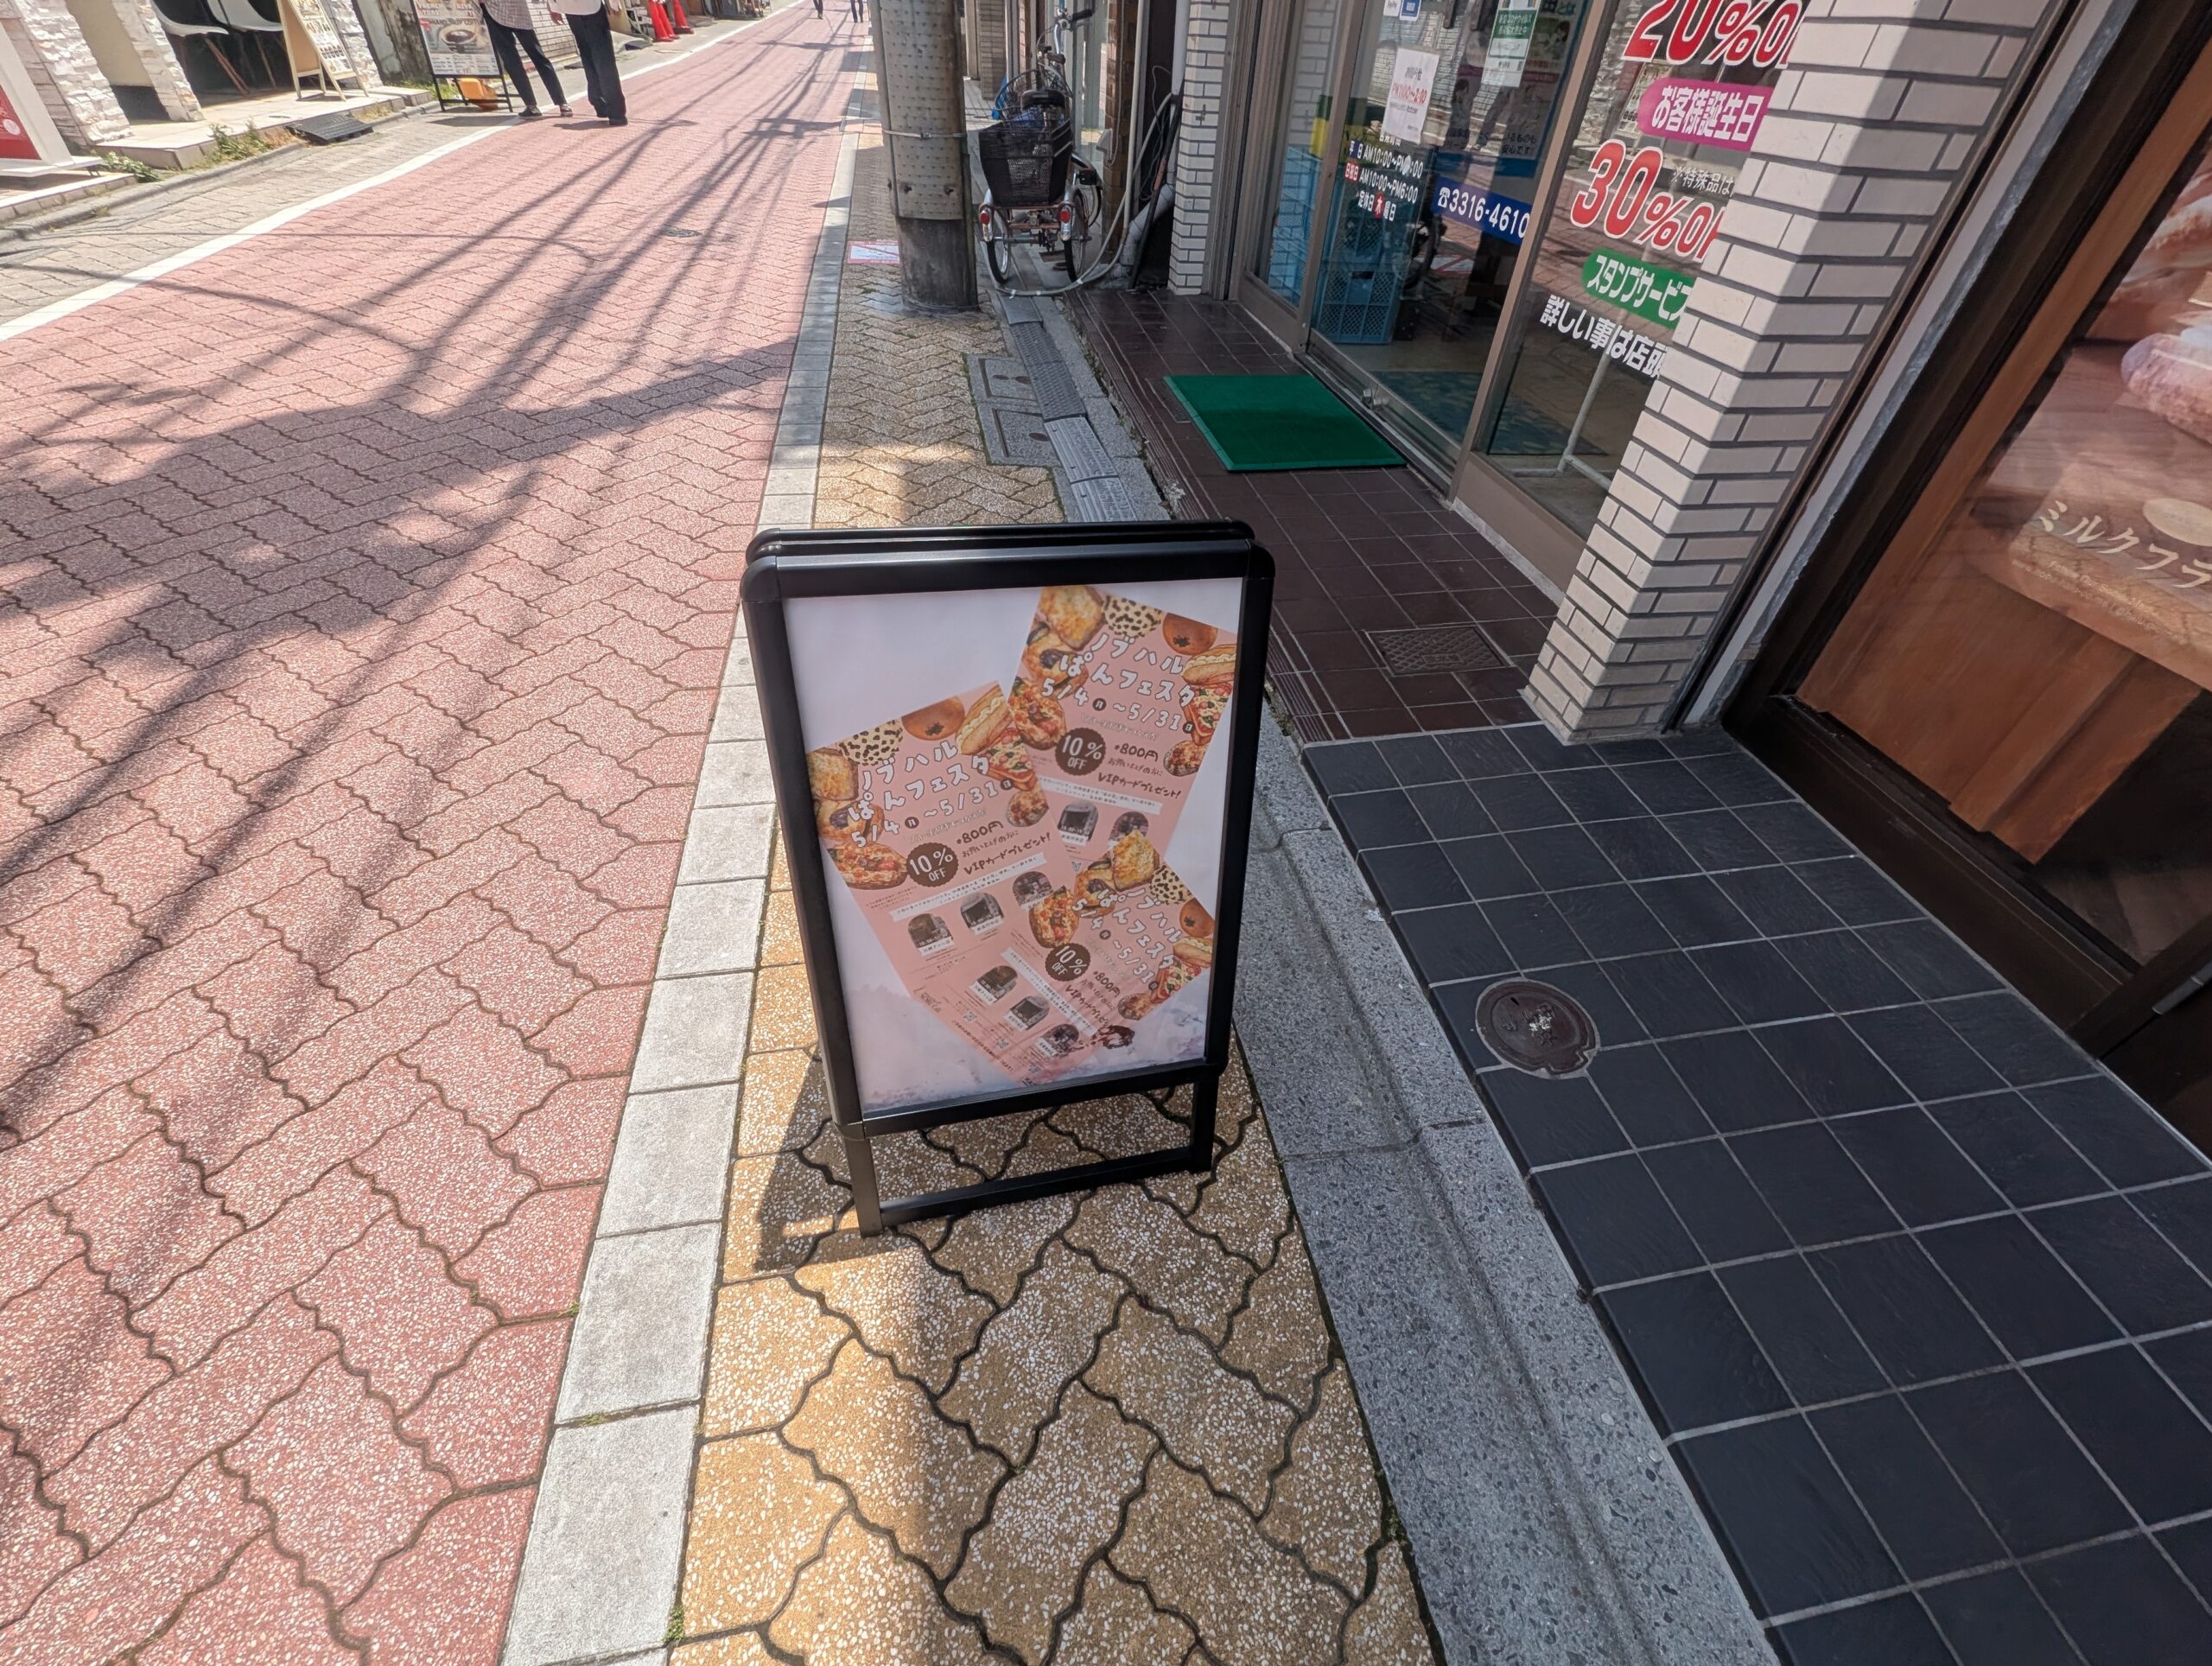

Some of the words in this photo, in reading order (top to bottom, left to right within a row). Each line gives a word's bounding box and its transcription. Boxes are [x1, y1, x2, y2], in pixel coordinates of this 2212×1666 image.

[1621, 0, 1802, 69] 20%O
[1651, 86, 1764, 143] お客様誕生日
[1363, 144, 1424, 179] AM10:00~PM:00
[1671, 165, 1734, 198] ※特殊品は
[1090, 632, 1185, 675] ノブハル
[1058, 650, 1196, 707] ぱんフェスタ
[1061, 734, 1104, 761] 10%
[1067, 756, 1087, 771] OFF
[862, 740, 959, 792] ノブハル
[847, 754, 990, 822] ぱんフェスタ
[908, 847, 955, 875] 10%
[927, 867, 949, 882] OFF
[1126, 887, 1183, 943] ノブハル
[1051, 962, 1069, 976] OFF
[1054, 944, 1088, 976] 10%
